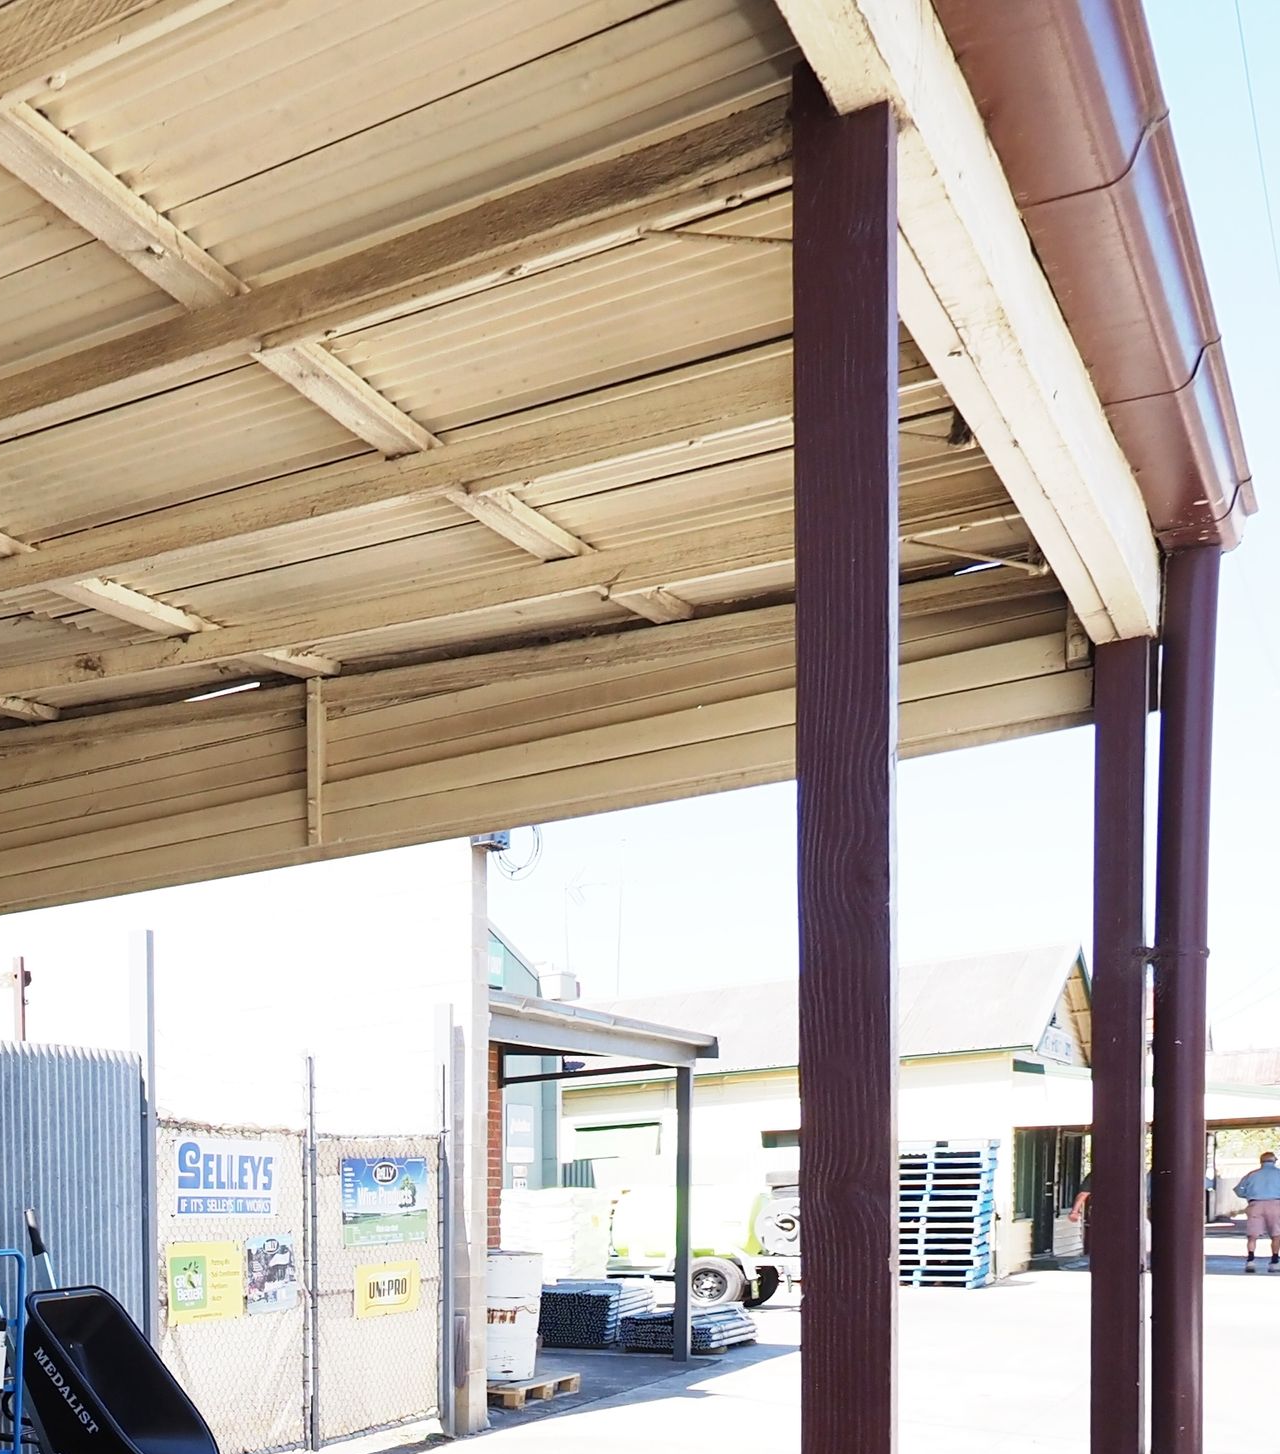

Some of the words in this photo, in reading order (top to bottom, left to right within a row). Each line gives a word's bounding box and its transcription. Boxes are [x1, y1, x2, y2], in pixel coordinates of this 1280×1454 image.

[177, 1141, 274, 1191] SELLEYS
[180, 1199, 188, 1213] IF
[190, 1199, 204, 1213] IT'S
[206, 1199, 236, 1213] SELLEYS
[236, 1199, 244, 1213] IT
[357, 1186, 377, 1206] Wire
[33, 1346, 100, 1434] MEDALIST
